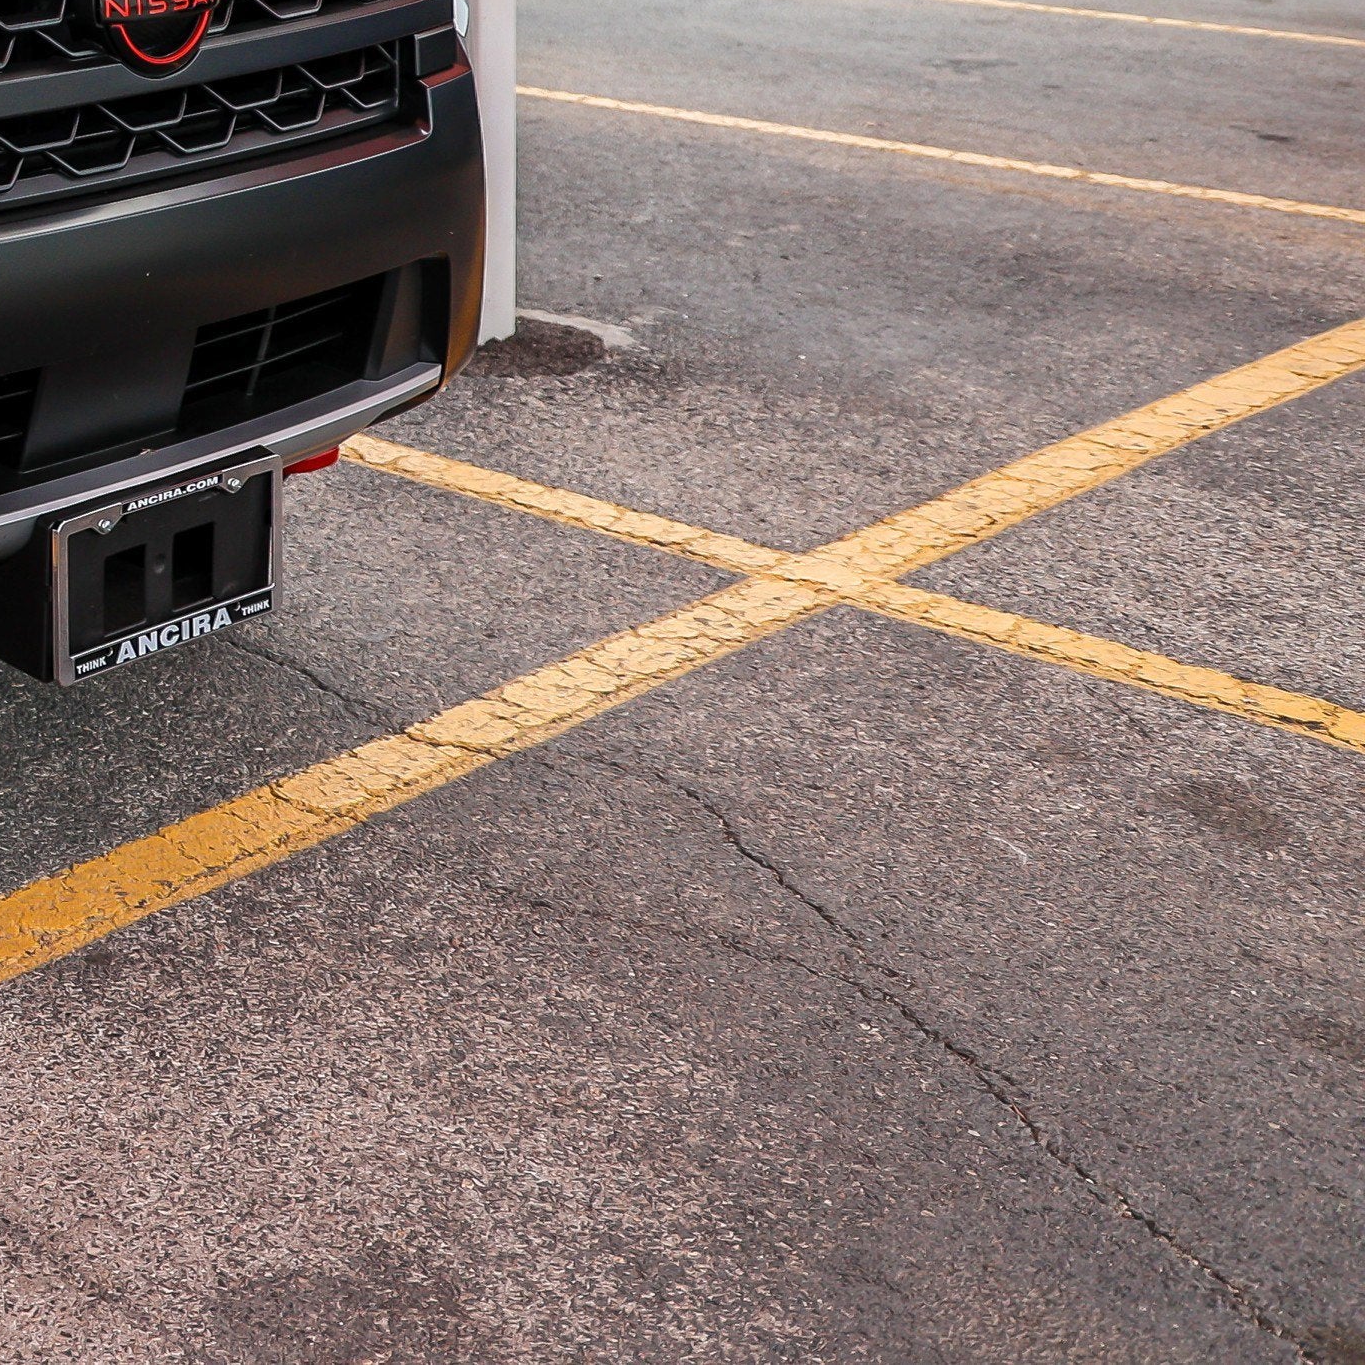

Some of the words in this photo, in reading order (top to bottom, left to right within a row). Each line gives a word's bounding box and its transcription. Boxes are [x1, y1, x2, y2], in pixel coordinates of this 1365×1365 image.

[126, 476, 219, 512] ANCIRA.COM
[76, 656, 107, 674] THINK
[115, 607, 232, 664] ANCIRA
[241, 599, 270, 617] THINK
